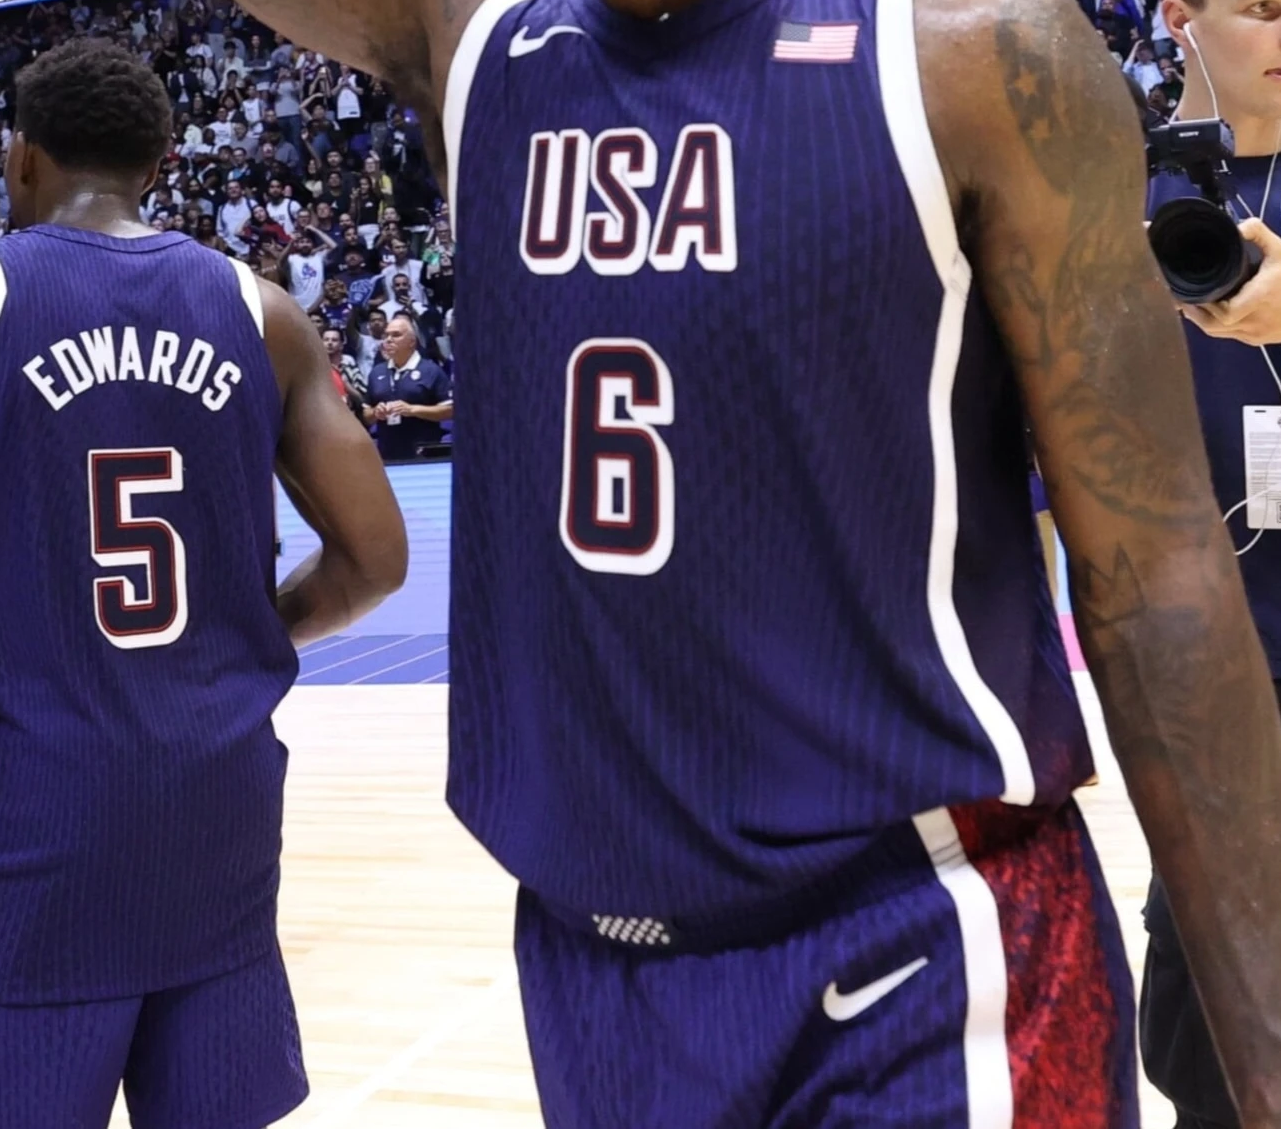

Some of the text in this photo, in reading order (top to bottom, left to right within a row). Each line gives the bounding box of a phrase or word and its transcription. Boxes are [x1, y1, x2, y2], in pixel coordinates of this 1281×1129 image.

[519, 122, 738, 276] USA
[22, 325, 243, 412] EDWARDS
[558, 336, 675, 576] 6
[88, 446, 189, 650] 5
